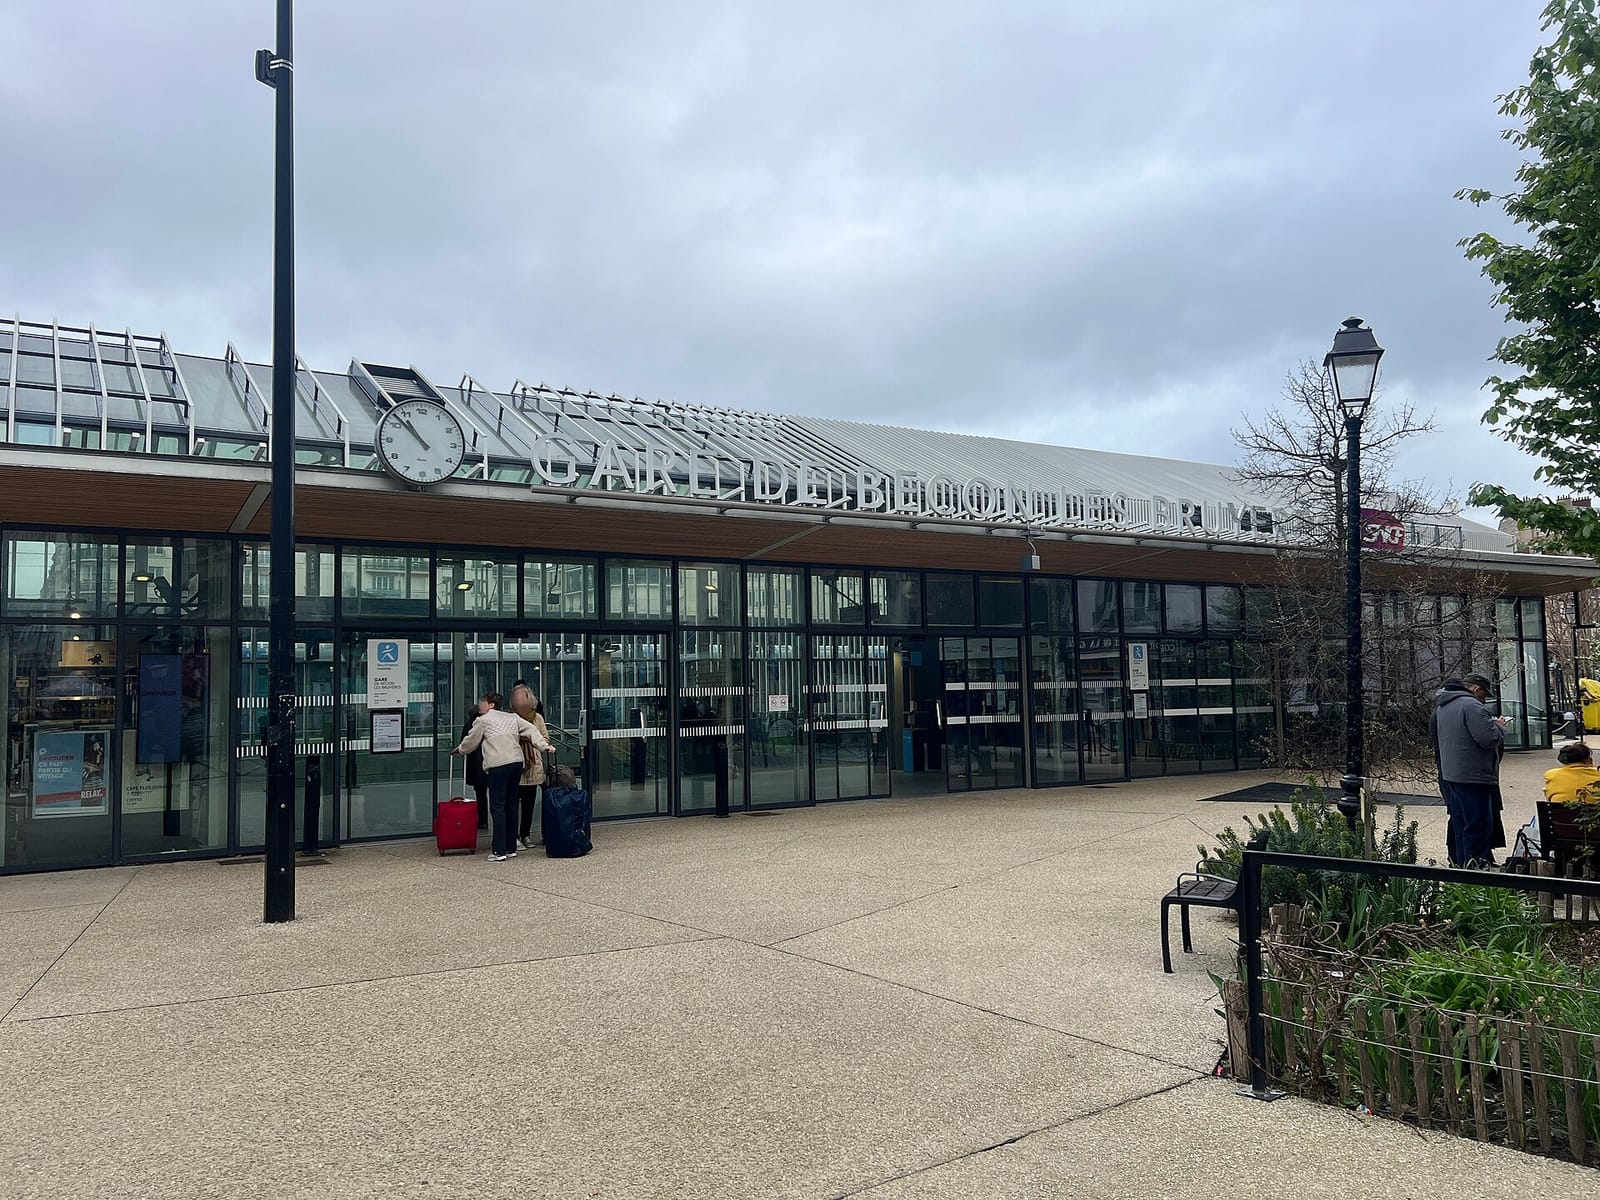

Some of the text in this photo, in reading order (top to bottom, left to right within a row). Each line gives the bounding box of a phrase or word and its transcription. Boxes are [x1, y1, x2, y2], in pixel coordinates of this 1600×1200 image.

[530, 432, 720, 498] GARE
[754, 455, 828, 505] DE
[1059, 486, 1130, 528] LES
